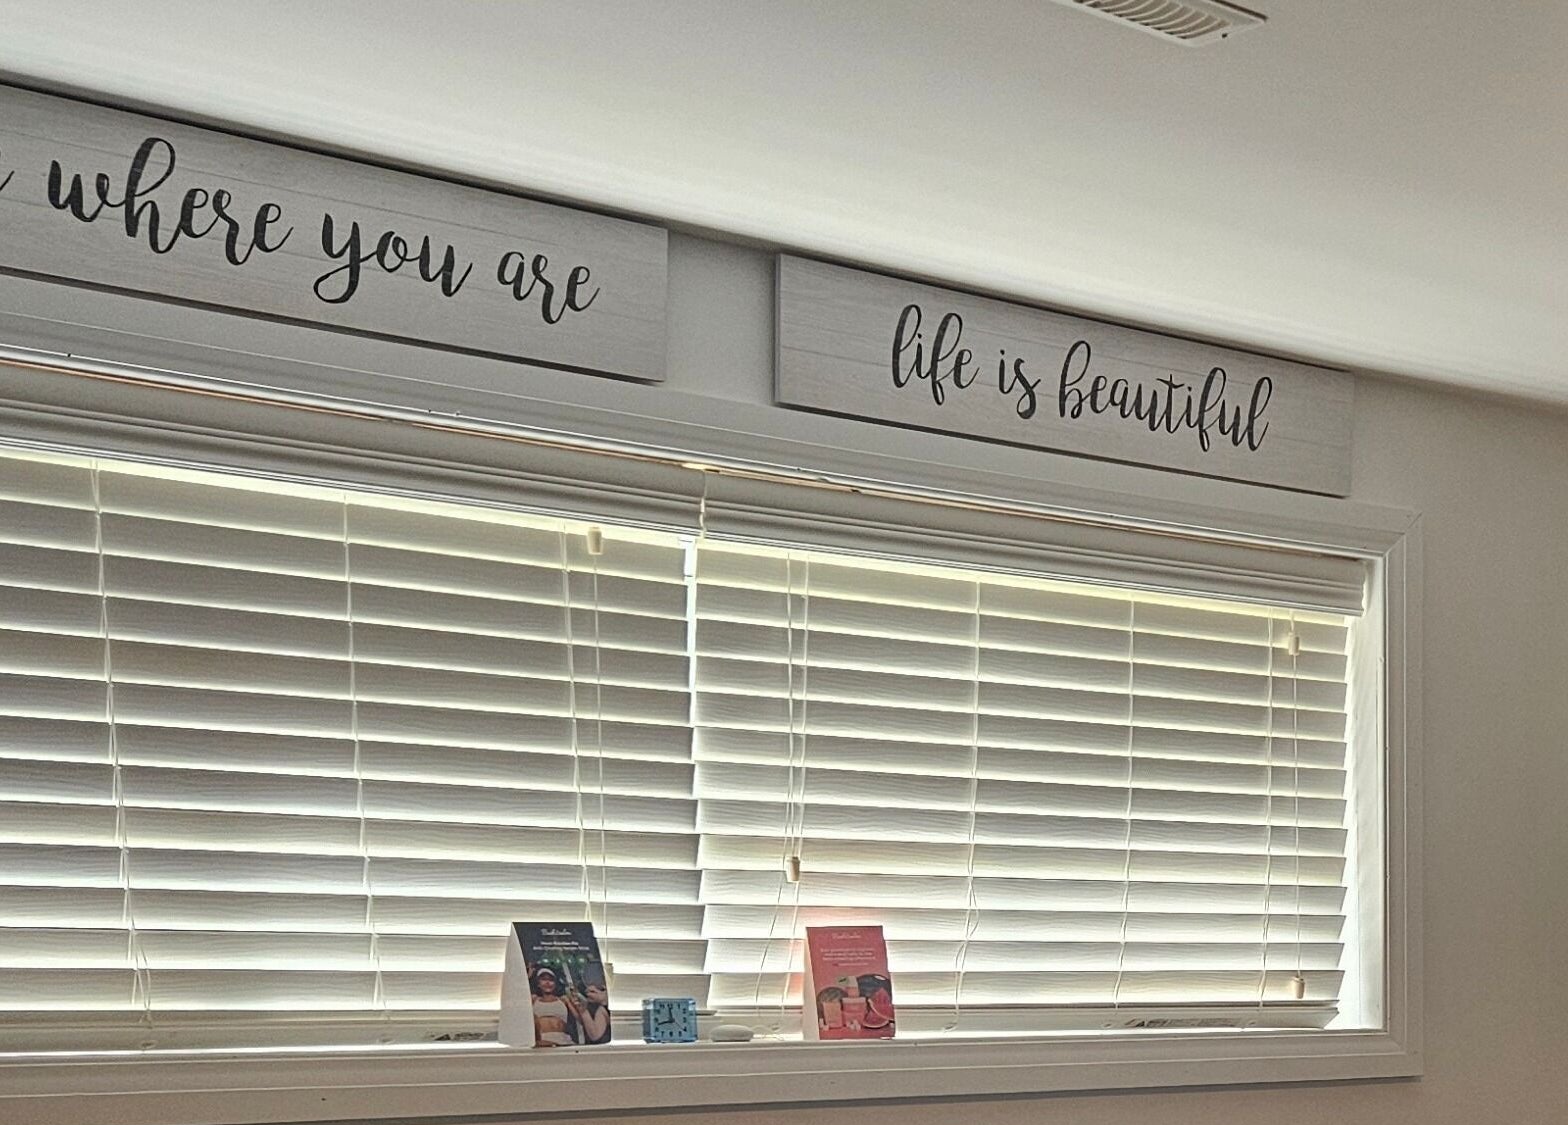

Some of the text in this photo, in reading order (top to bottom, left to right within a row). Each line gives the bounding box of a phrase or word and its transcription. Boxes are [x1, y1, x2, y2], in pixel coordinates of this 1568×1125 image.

[48, 136, 600, 324] where you are
[891, 303, 1272, 452] life is beautiful
